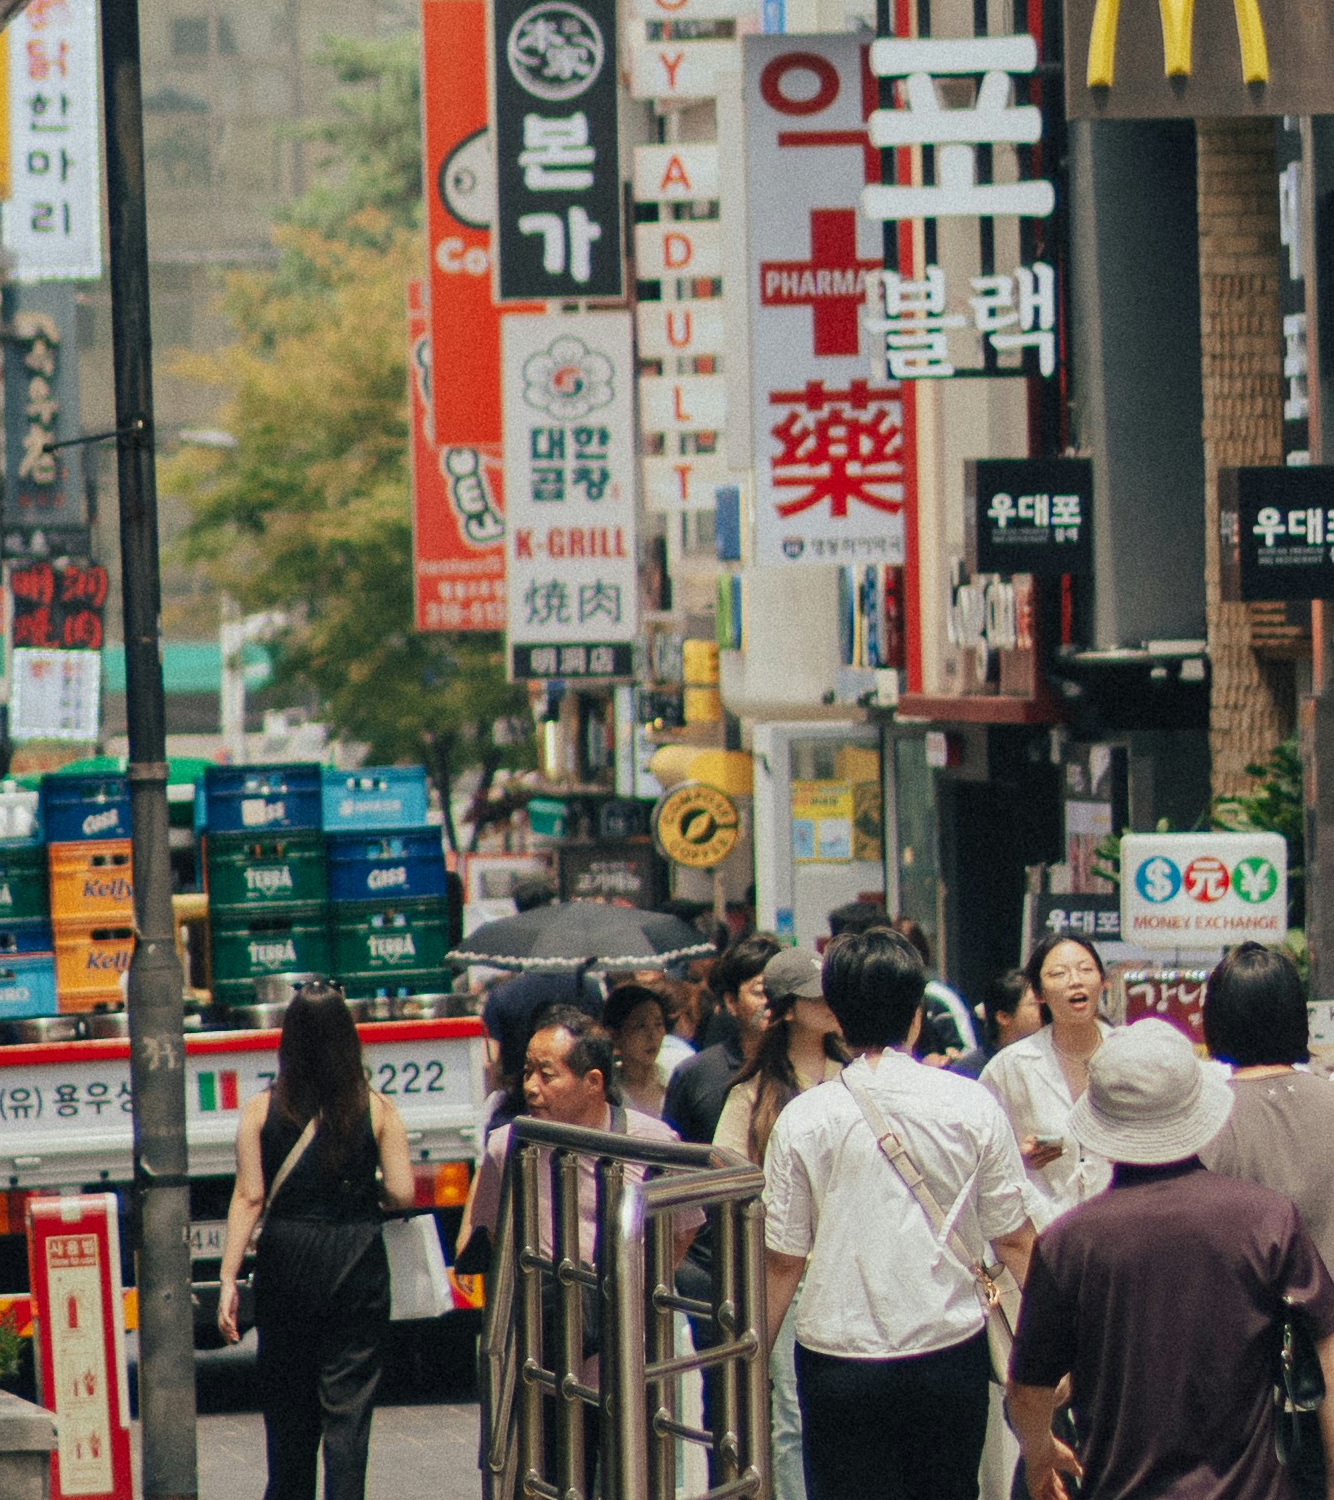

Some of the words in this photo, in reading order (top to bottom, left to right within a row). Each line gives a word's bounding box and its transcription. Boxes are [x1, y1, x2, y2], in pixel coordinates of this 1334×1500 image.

[517, 111, 602, 283] 본가
[766, 263, 870, 297] PHARMA
[862, 262, 1056, 380] 블랙
[769, 380, 903, 518] 藥
[987, 493, 1082, 528] 우대포
[514, 526, 625, 558] K-GRILL
[244, 865, 293, 892] TERRA
[1185, 857, 1229, 899] 元
[1045, 909, 1121, 934] 우대포
[1133, 915, 1190, 932] MONEY
[1194, 914, 1279, 931] EXCHANGE
[86, 951, 129, 970] Kell
[247, 938, 297, 965] TERRA
[368, 933, 416, 959] TERRA
[366, 1060, 446, 1099] 222
[0, 1086, 43, 1121] (유)
